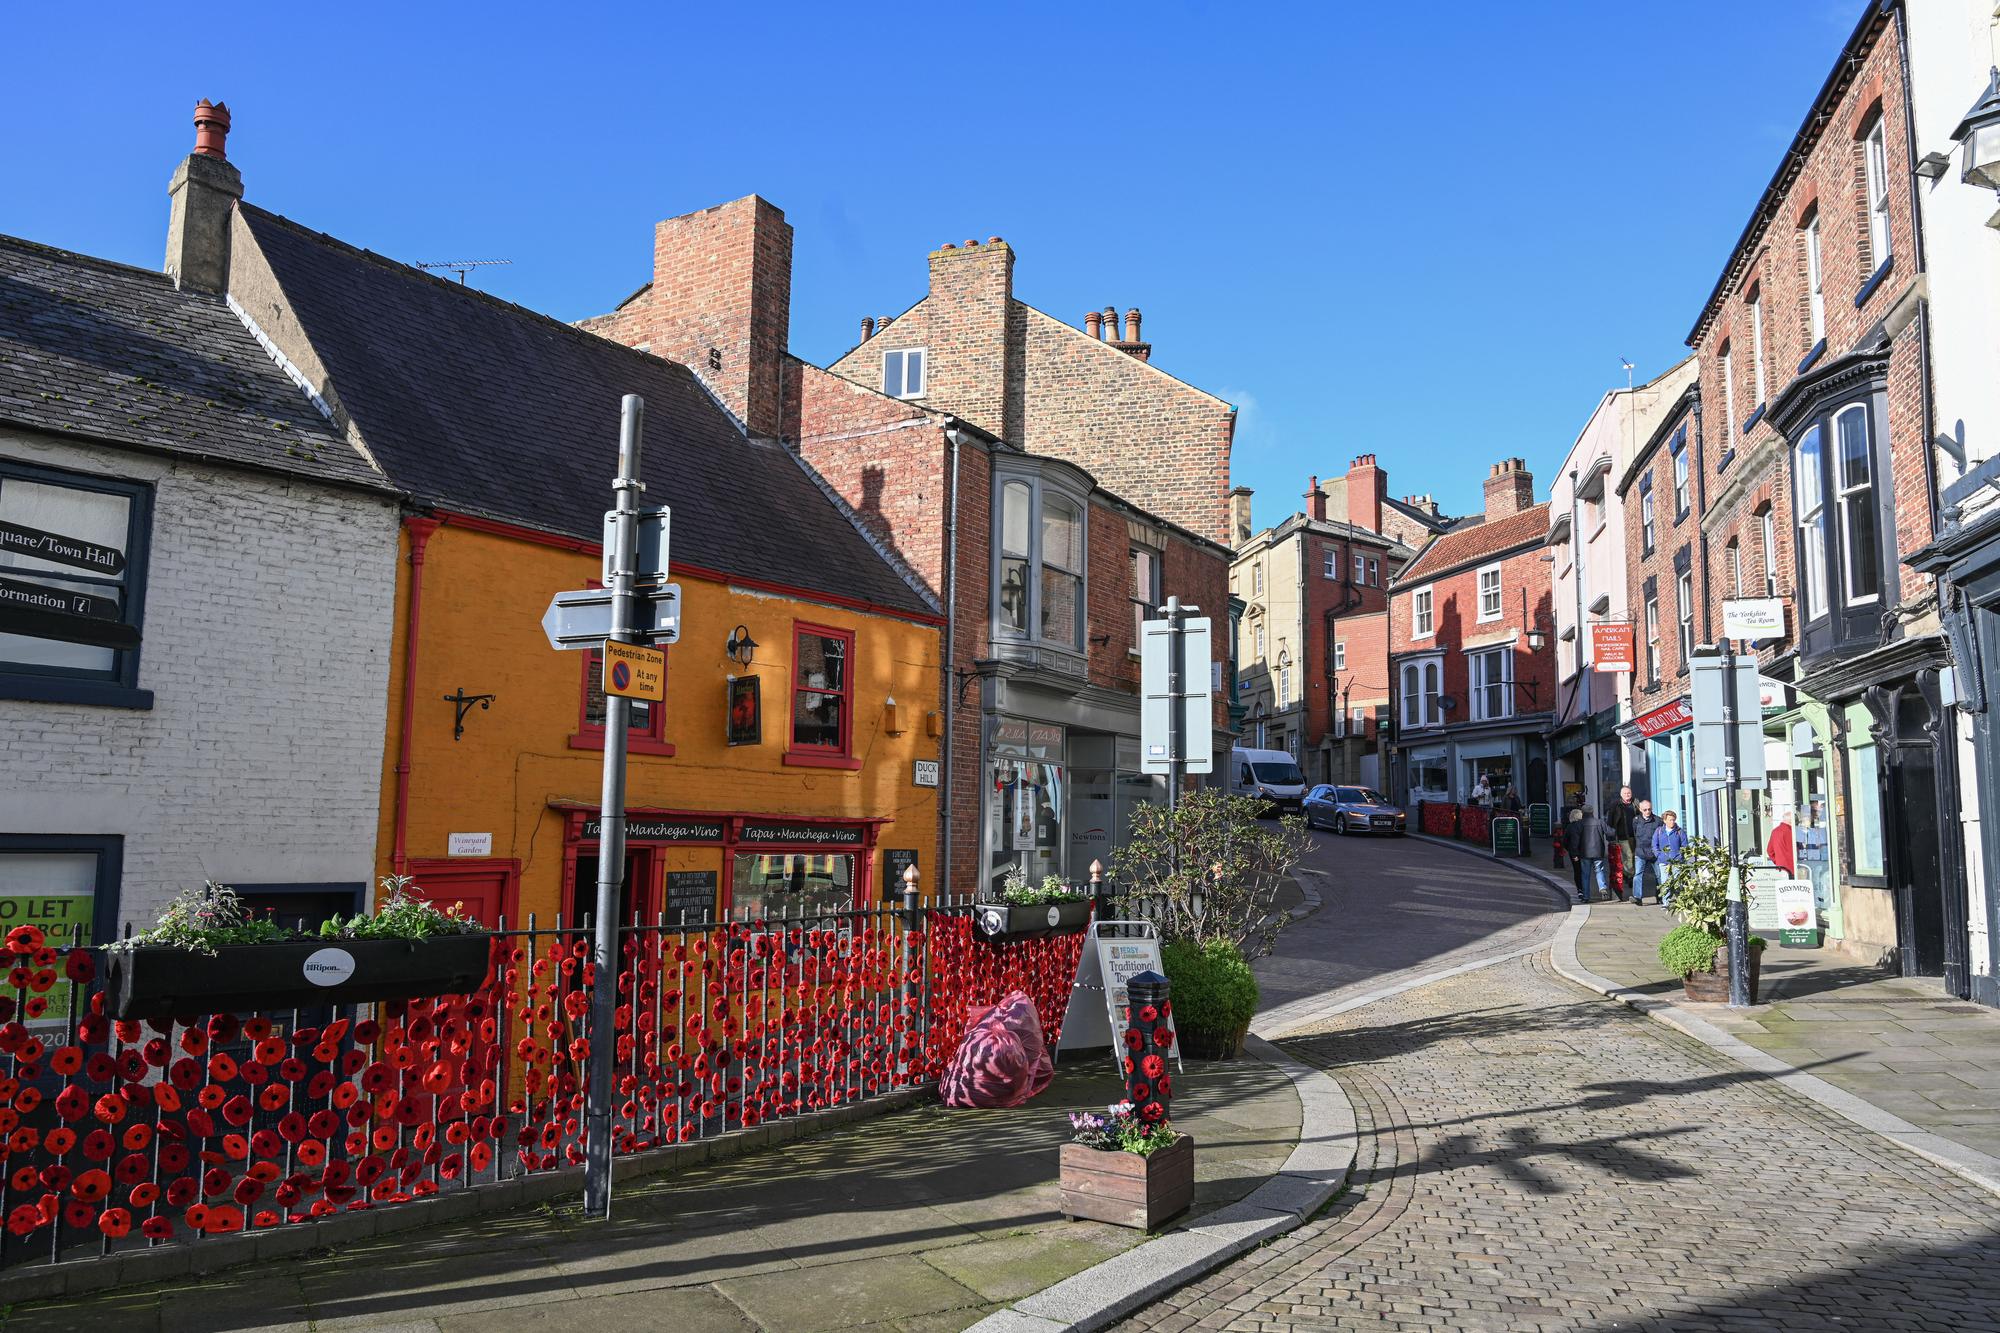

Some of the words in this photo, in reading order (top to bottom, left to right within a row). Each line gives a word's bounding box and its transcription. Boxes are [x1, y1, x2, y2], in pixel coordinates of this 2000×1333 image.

[85, 547, 114, 566] Hall
[0, 583, 66, 609] ormation
[1739, 610, 1767, 618] Yorkshire
[608, 645, 646, 661] Pedestrian
[646, 652, 663, 665] Zone
[636, 669, 645, 680] At
[646, 672, 657, 682] any
[640, 682, 654, 692] time
[917, 762, 937, 773] DUCK
[919, 773, 935, 783] HILL
[629, 823, 690, 839] Manchega
[694, 825, 720, 837] Vino
[745, 827, 776, 841] Tapas
[781, 828, 831, 843] Manchega
[835, 830, 857, 841] Vino
[1072, 832, 1107, 841] Newtons
[27, 899, 74, 919] LET
[313, 963, 337, 973] Ripon
[1109, 960, 1155, 971] Traditional
